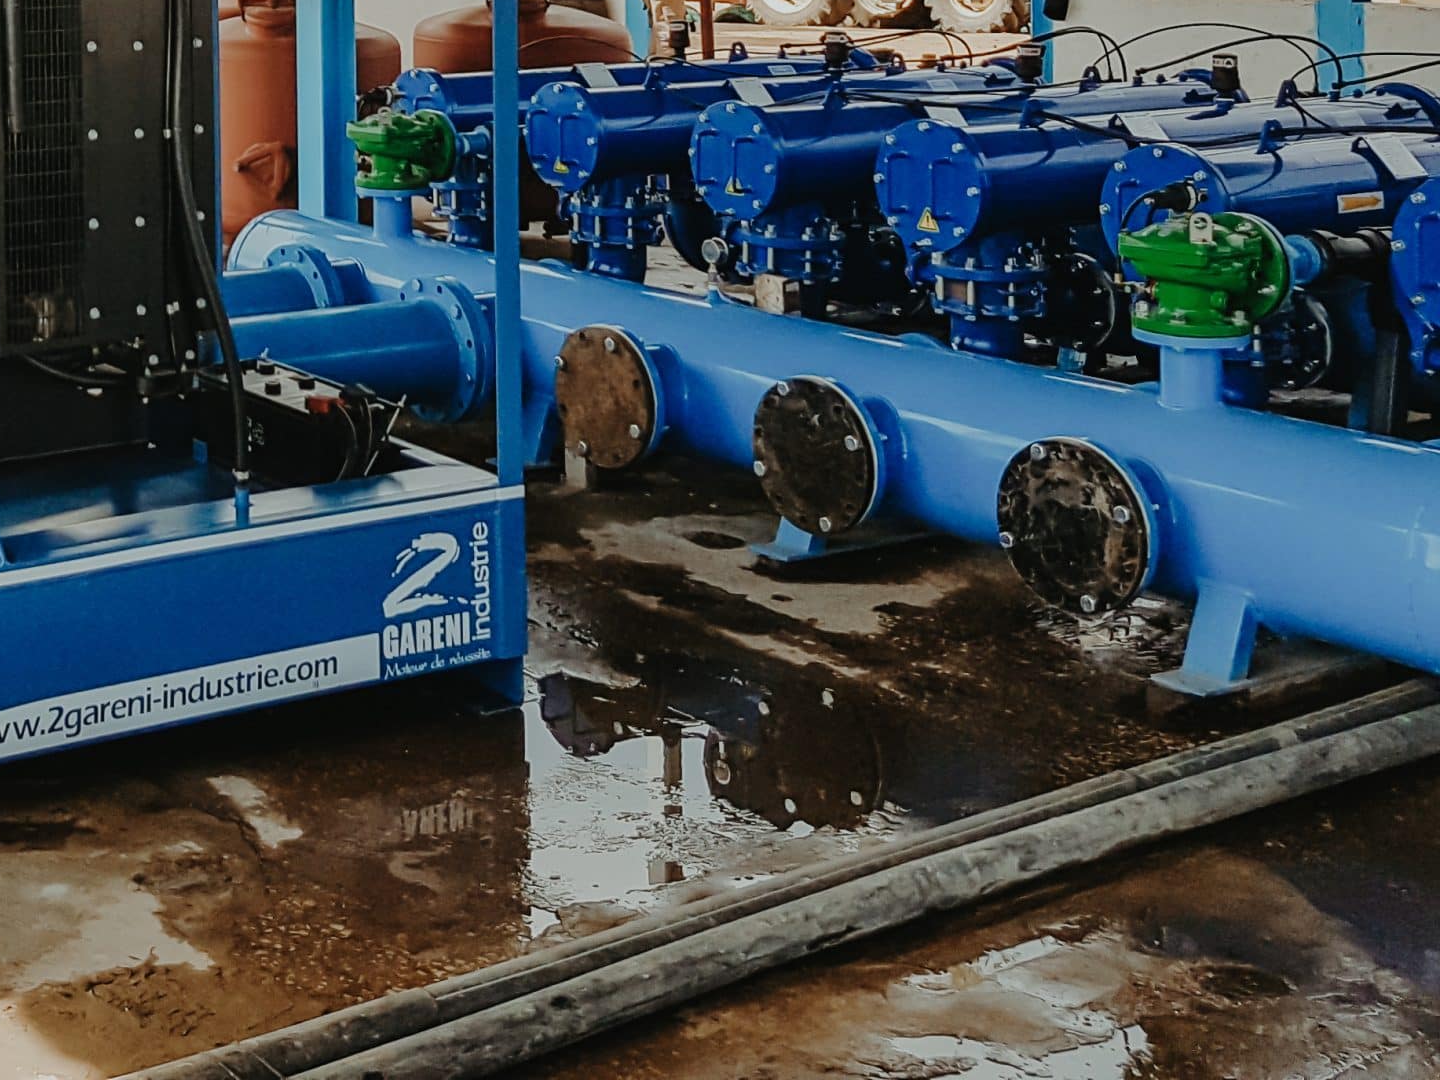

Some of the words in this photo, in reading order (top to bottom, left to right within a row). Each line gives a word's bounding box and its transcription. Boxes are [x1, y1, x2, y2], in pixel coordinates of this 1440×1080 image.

[383, 532, 466, 618] 2
[469, 521, 491, 641] industrie
[382, 612, 471, 659] GARENI
[431, 654, 445, 669] de
